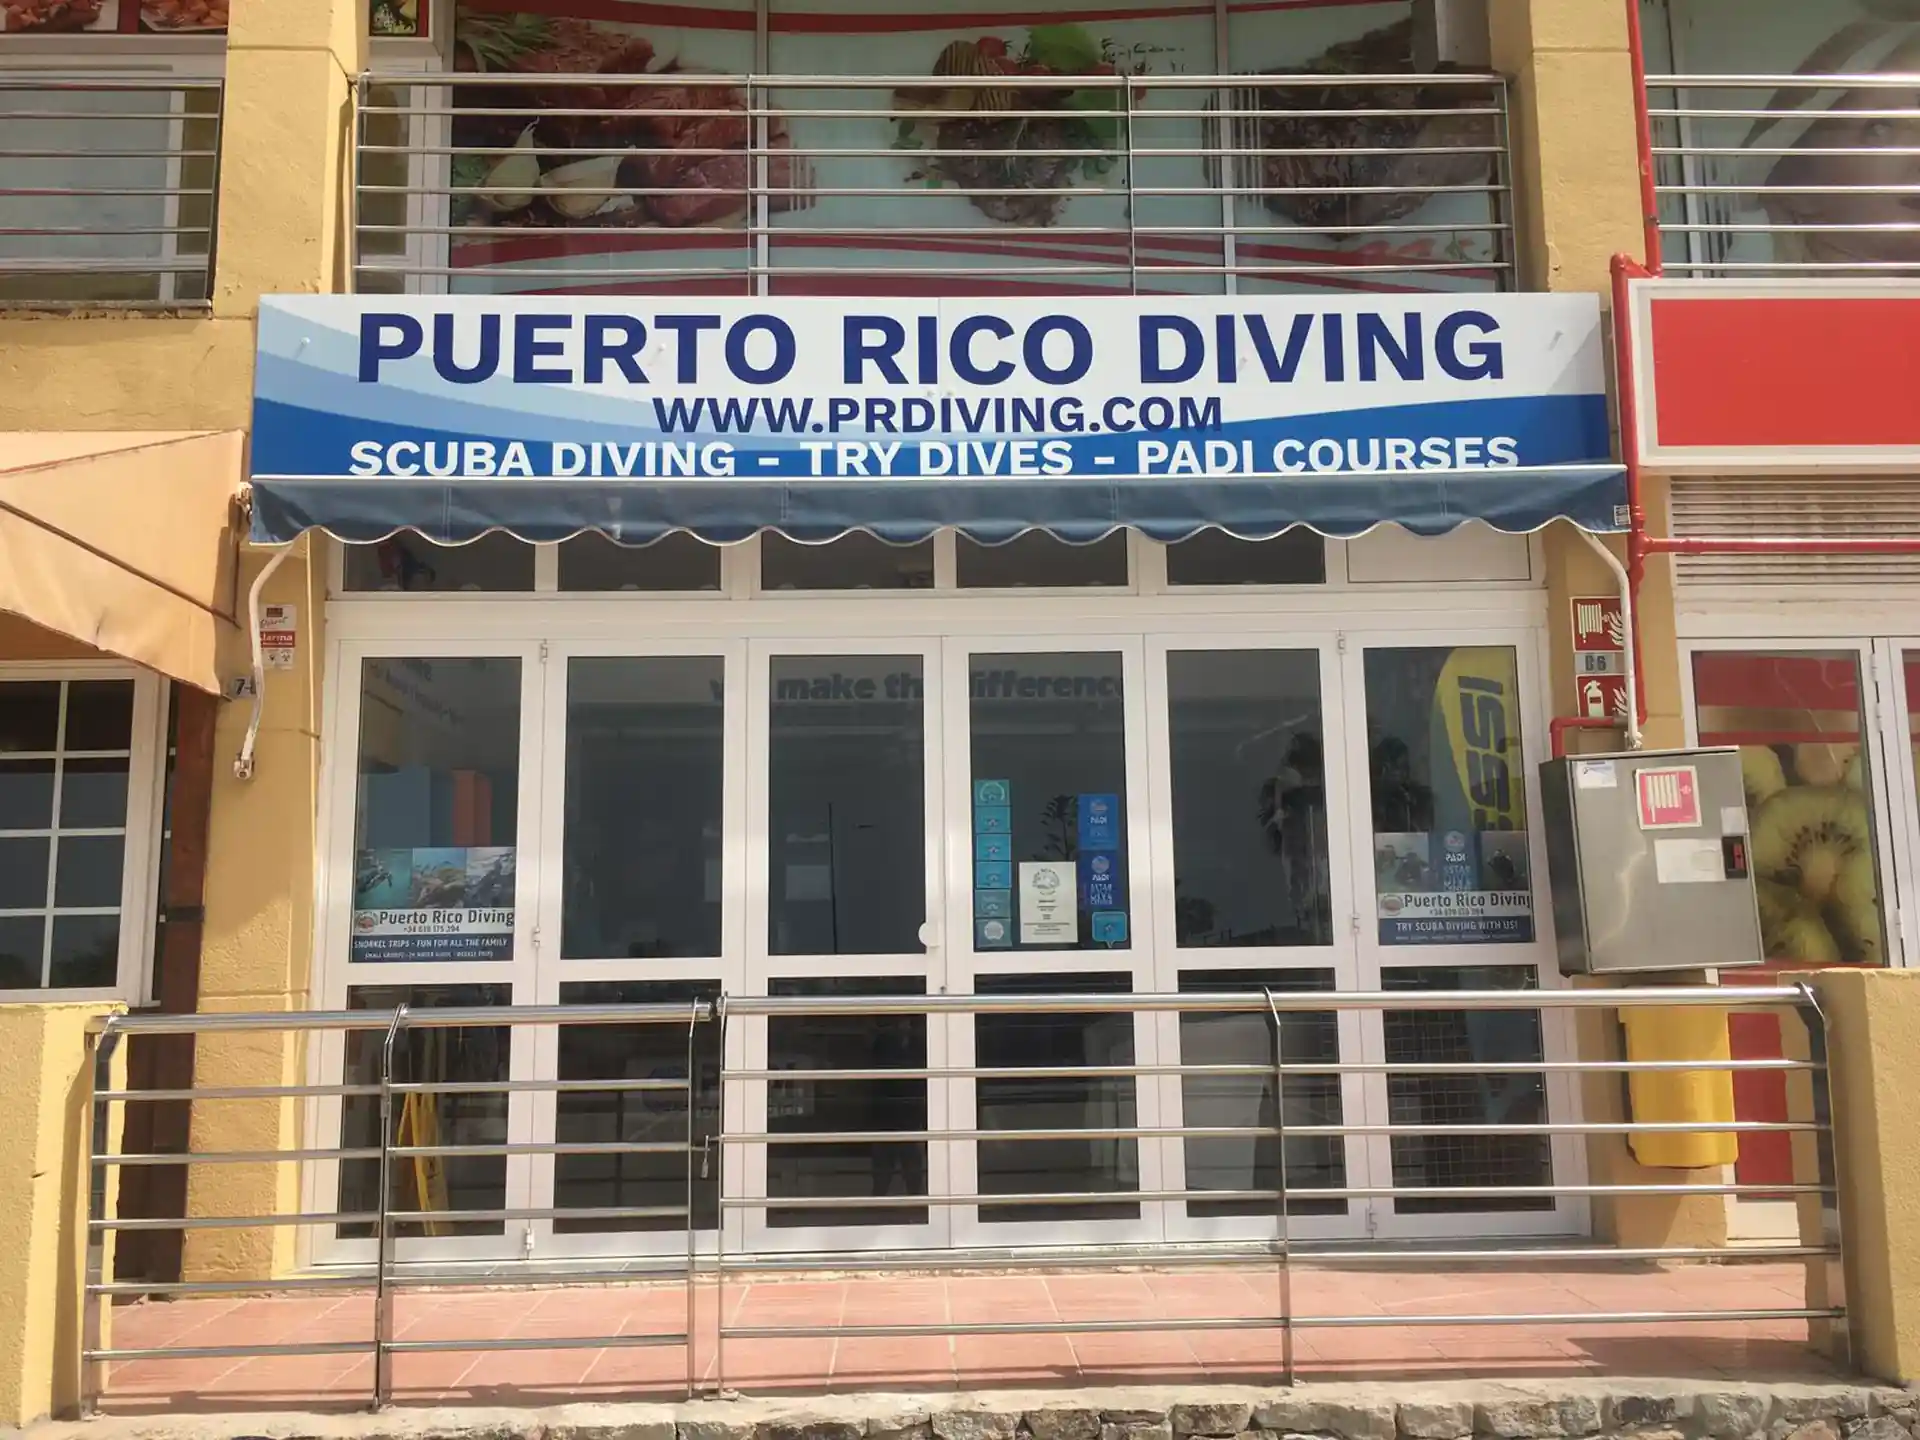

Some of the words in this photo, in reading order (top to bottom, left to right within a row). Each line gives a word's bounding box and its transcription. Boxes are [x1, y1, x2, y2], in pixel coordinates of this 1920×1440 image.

[357, 312, 797, 385] PUERTO
[842, 314, 1094, 386] RICO
[1138, 309, 1504, 385] DIVING
[652, 396, 1224, 434] WWW.PRDIVING.COM
[348, 440, 535, 477] SCUBA
[551, 440, 736, 477] DIVING
[798, 440, 903, 476] TRY
[918, 439, 1074, 476] DIVES
[1137, 439, 1254, 475] PADI
[1272, 436, 1519, 474] COURSES
[777, 673, 876, 700] make
[1404, 894, 1452, 908] Puerto
[1456, 893, 1486, 907] Rico
[379, 911, 428, 925] Puerto
[432, 910, 463, 924] Rico
[467, 909, 515, 927] Diving
